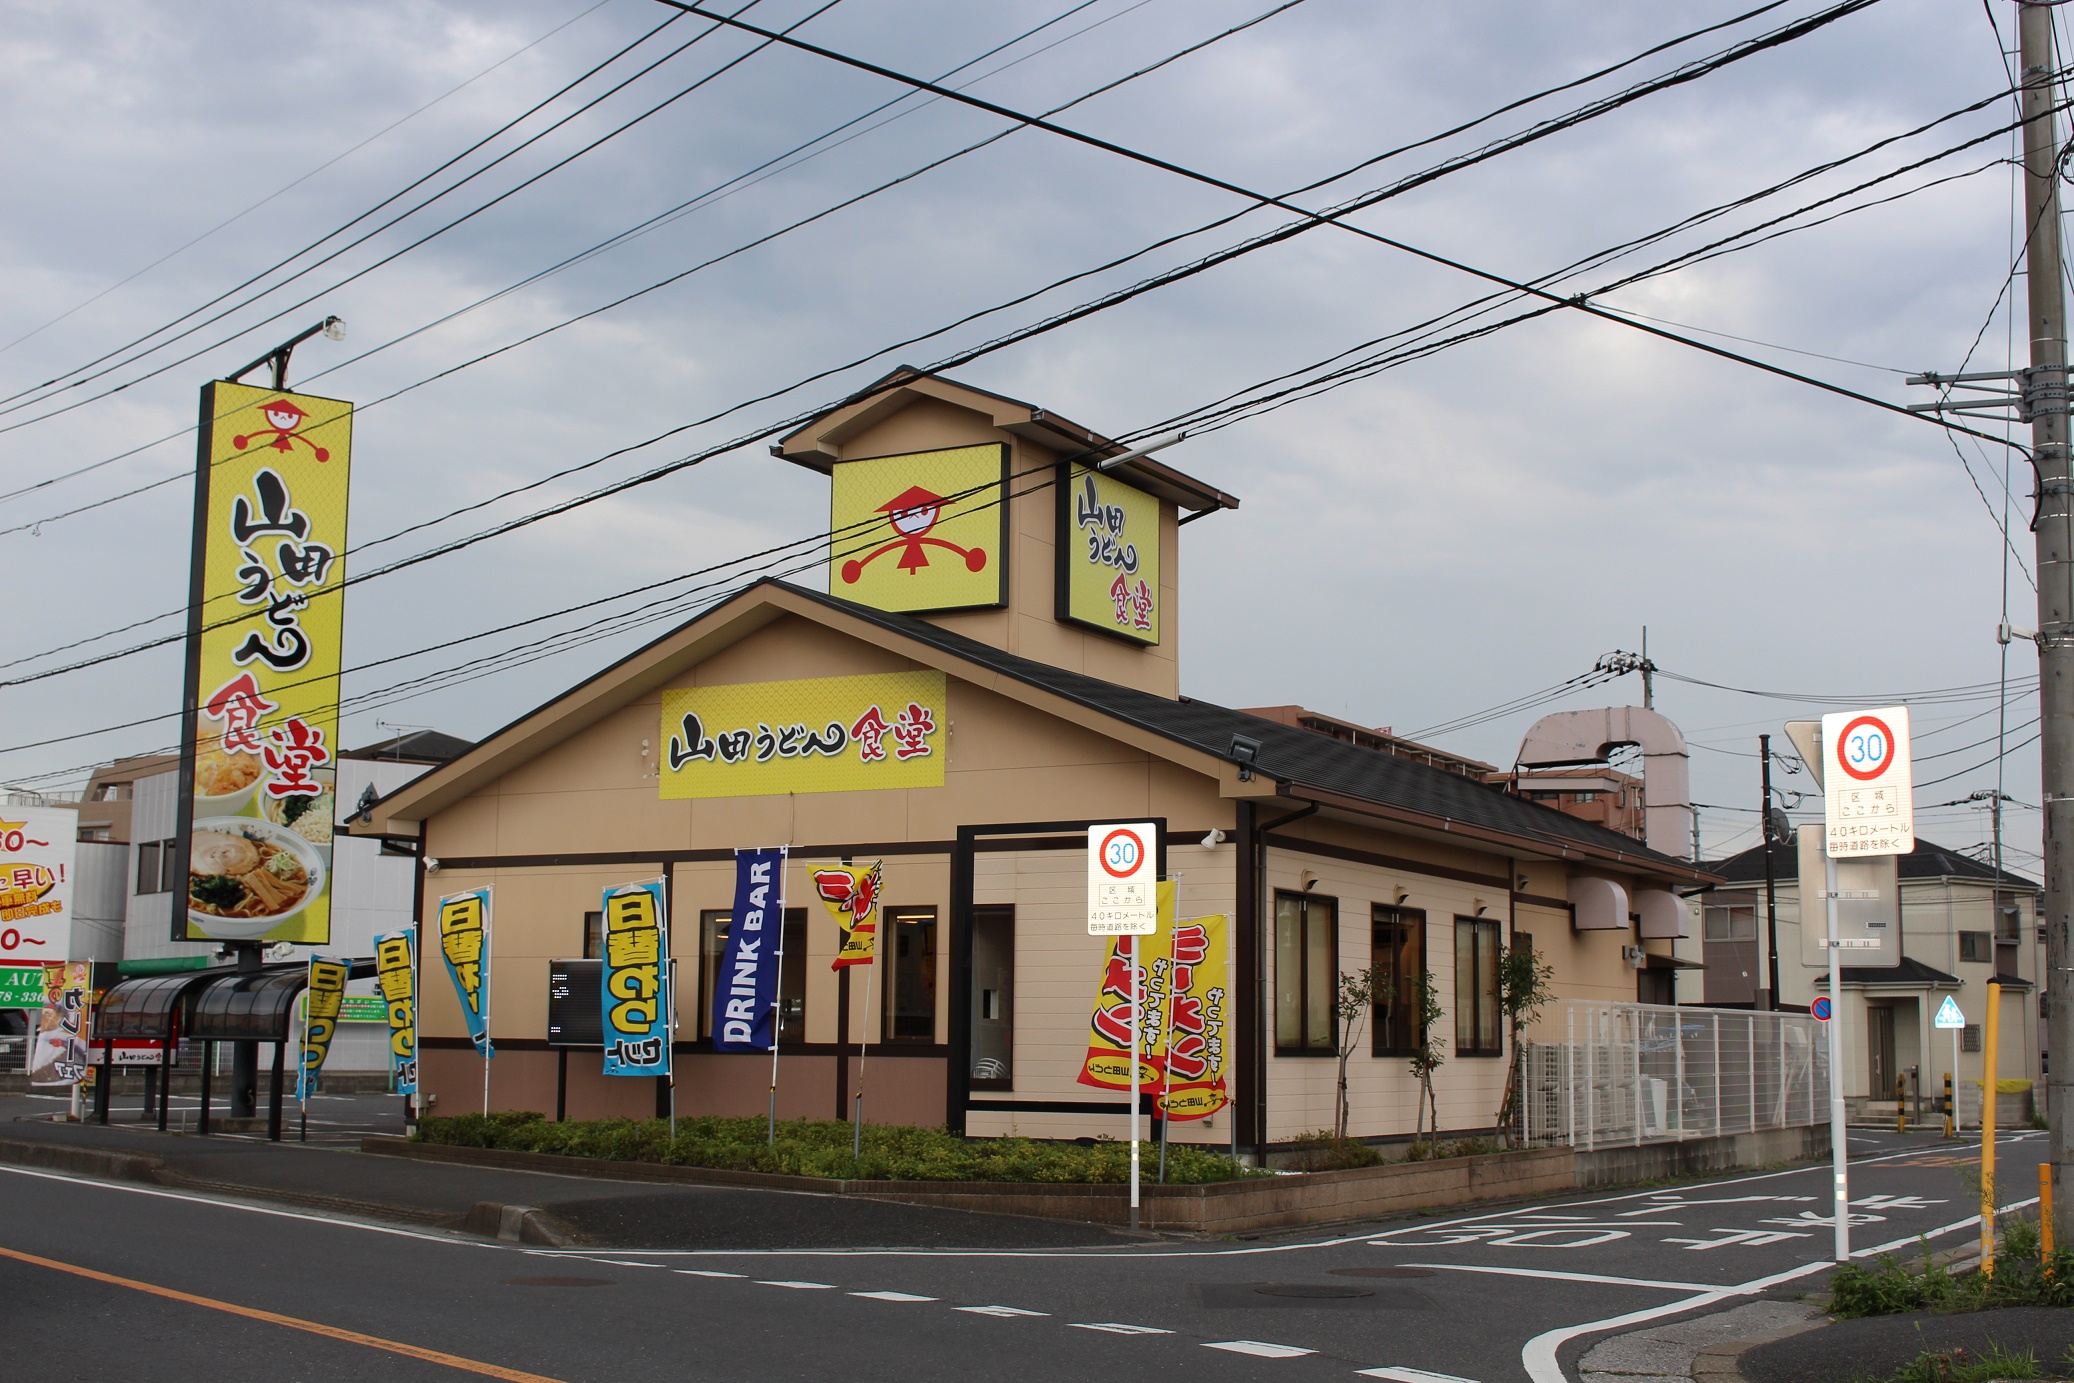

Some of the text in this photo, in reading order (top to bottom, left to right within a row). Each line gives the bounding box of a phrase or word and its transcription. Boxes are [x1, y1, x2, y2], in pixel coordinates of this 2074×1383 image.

[1110, 572, 1154, 630] 食堂
[1851, 734, 1882, 763] 30
[1842, 804, 1895, 816] ここから
[1830, 823, 1911, 837] 40キロメートル
[1110, 843, 1135, 864] 30
[1101, 896, 1143, 905] ここから
[1091, 911, 1154, 921] 40キロメートル
[723, 860, 771, 1043] DRINK BAR
[1366, 1229, 1632, 1248] 30
